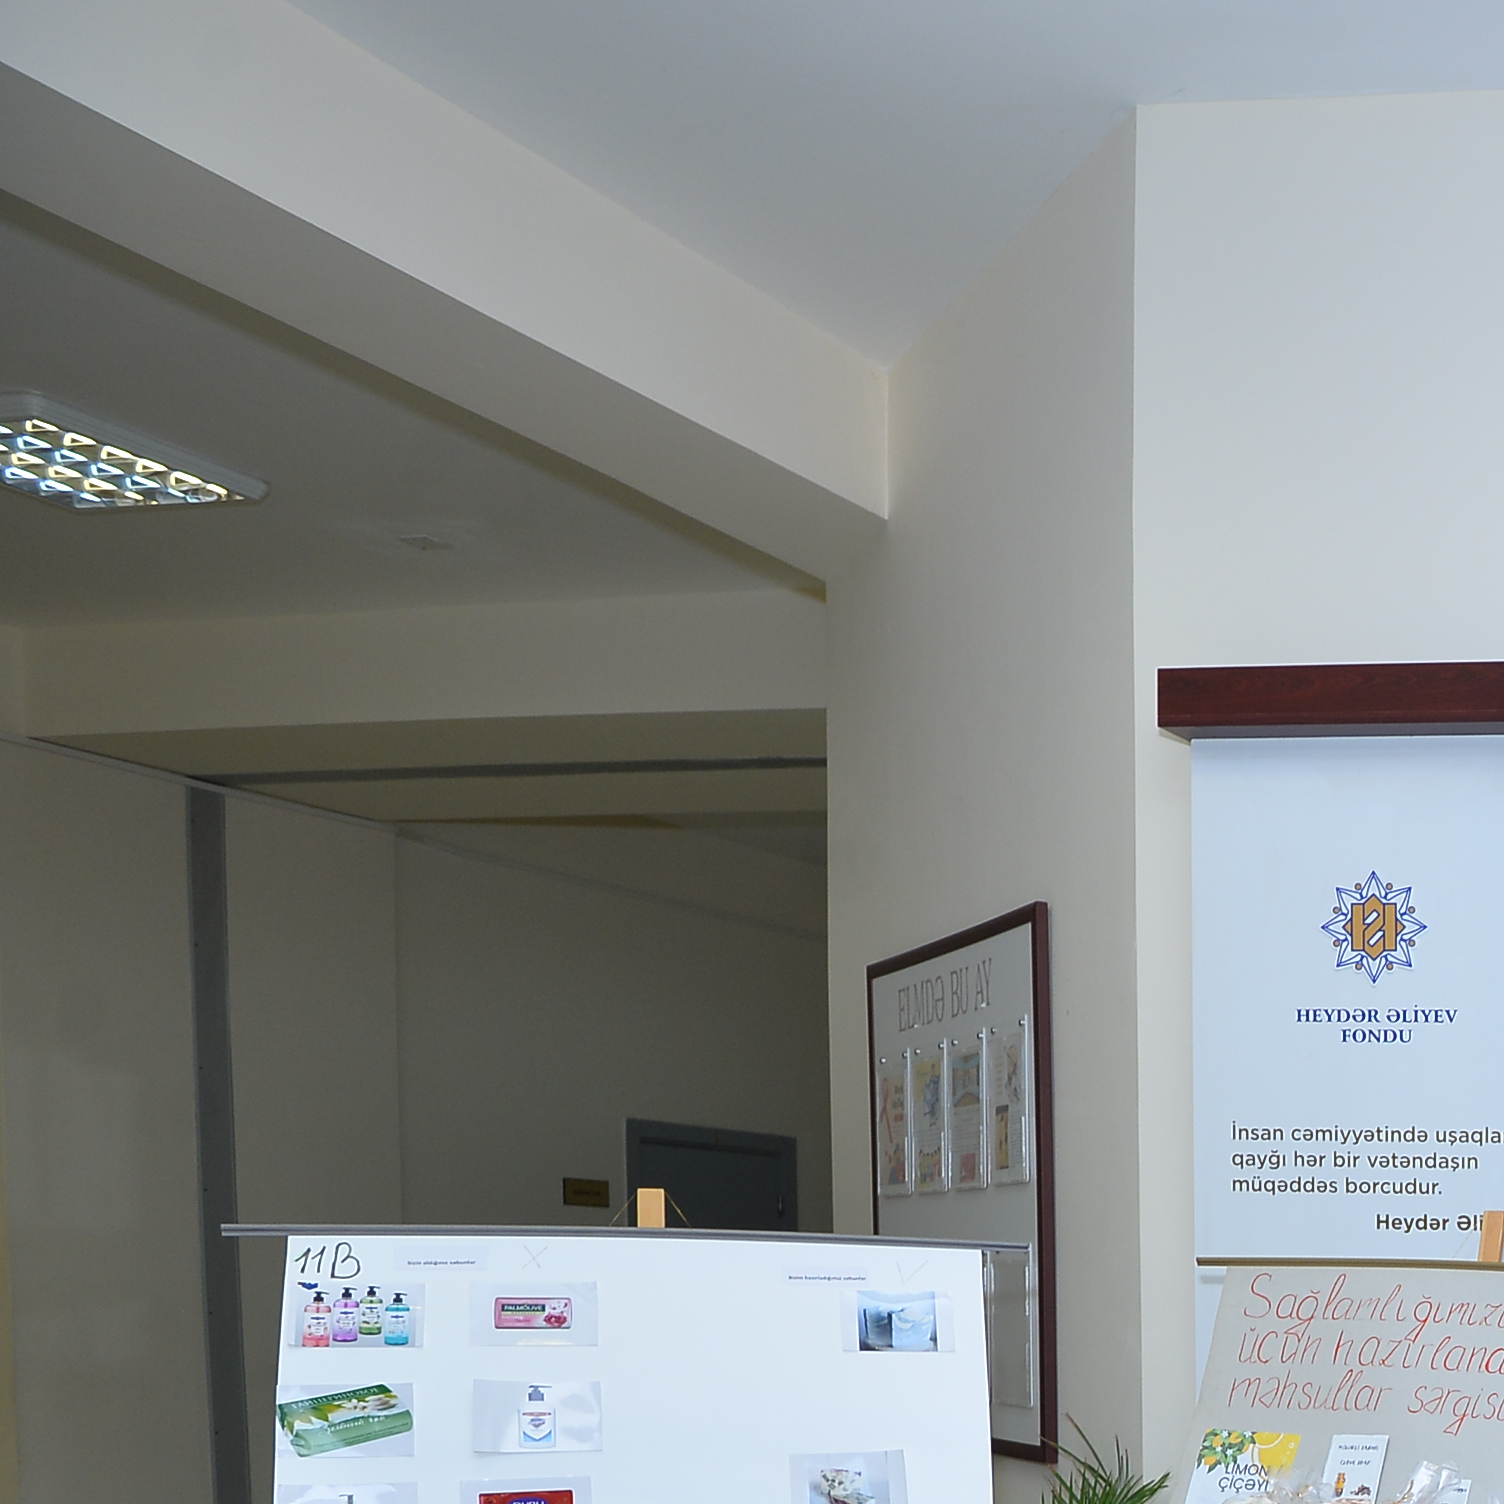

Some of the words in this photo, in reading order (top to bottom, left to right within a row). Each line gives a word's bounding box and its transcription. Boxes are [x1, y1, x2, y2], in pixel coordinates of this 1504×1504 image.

[898, 976, 945, 1032] ELMDƏ
[950, 965, 970, 1018] BU
[974, 957, 993, 1011] AY
[1296, 1008, 1380, 1023] HEYDƏR
[1386, 1004, 1458, 1023] ƏLİYEV
[1340, 1028, 1413, 1044] FONDU
[1231, 1121, 1284, 1141] İnsan
[1291, 1124, 1428, 1146] cəmiyyətində
[1231, 1150, 1286, 1170] qayğı
[1294, 1151, 1326, 1168] hər
[1333, 1152, 1360, 1168] bir
[1367, 1152, 1479, 1173] vətəndaşın
[1231, 1175, 1338, 1196] müqəddəs
[1345, 1177, 1443, 1195] borcudur.
[1376, 1214, 1449, 1234] Heydər
[1227, 1368, 1393, 1412] məhsullar
